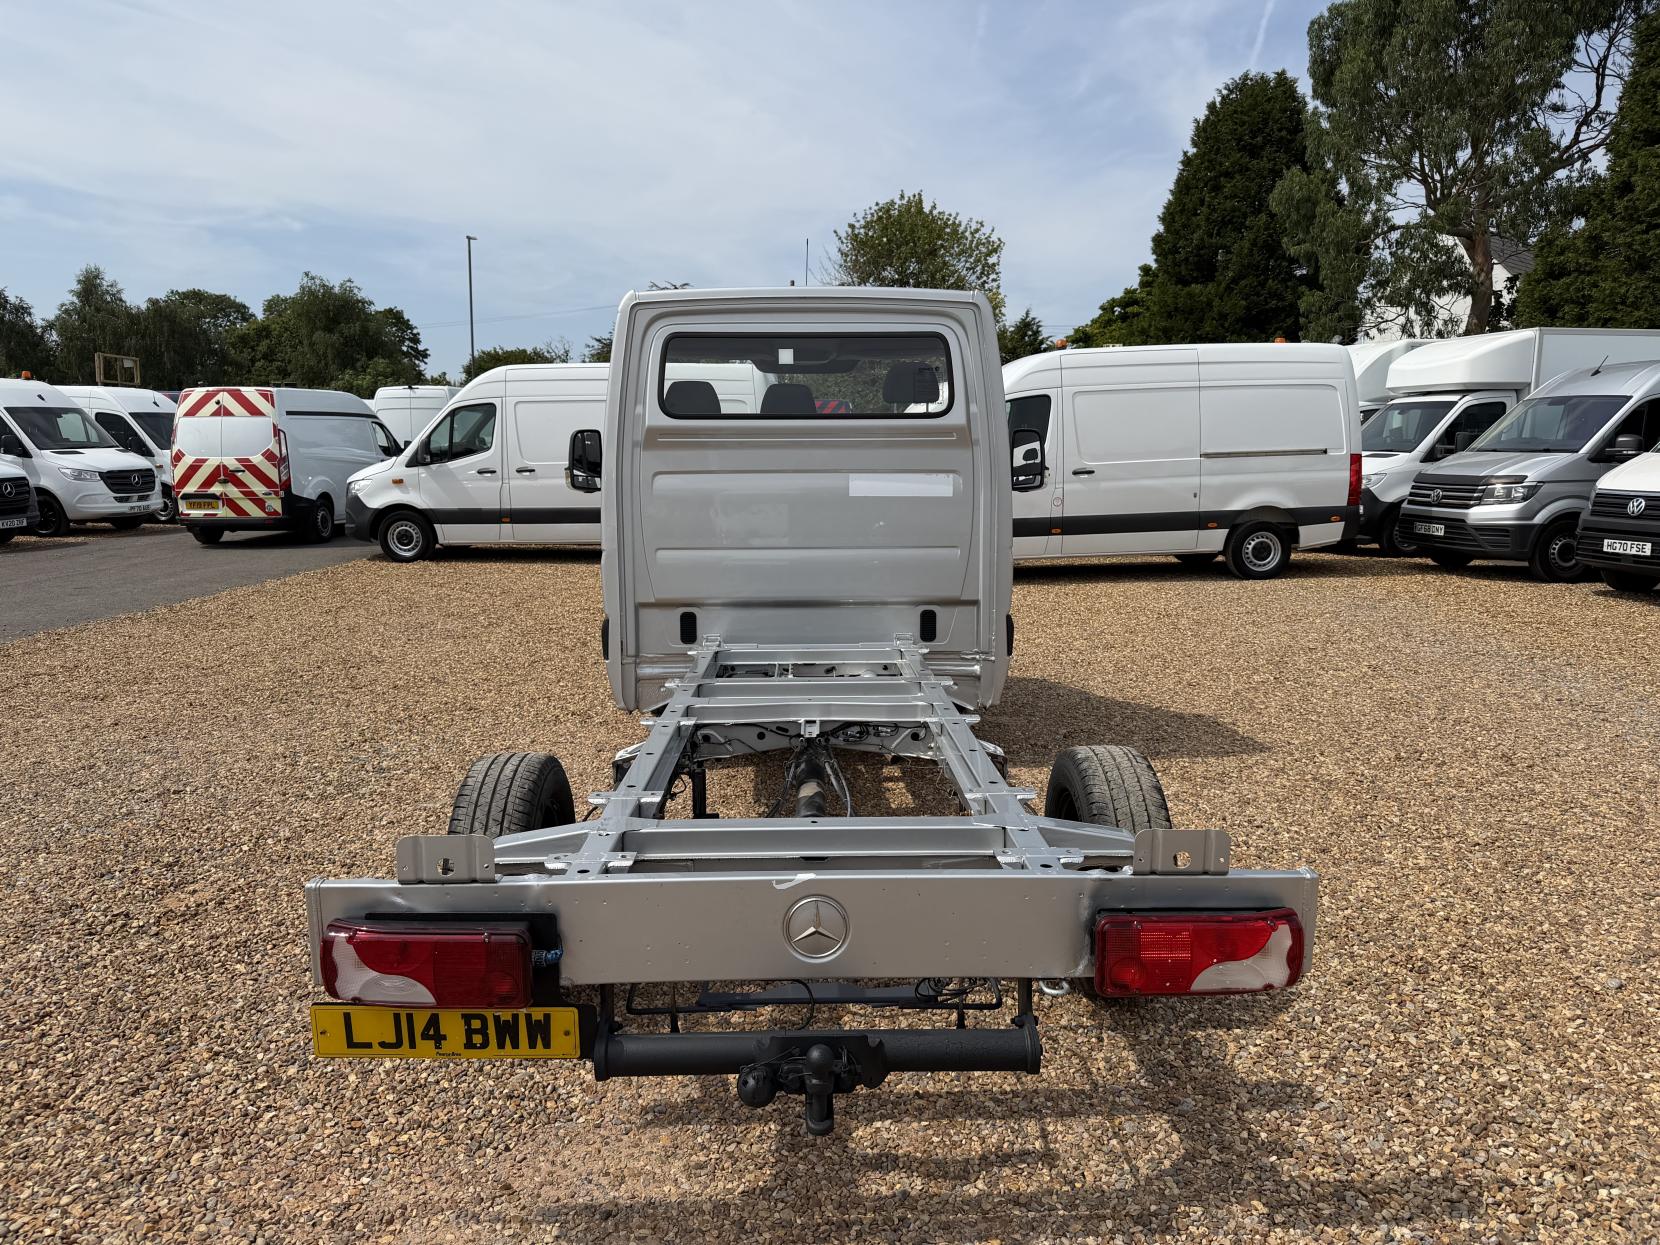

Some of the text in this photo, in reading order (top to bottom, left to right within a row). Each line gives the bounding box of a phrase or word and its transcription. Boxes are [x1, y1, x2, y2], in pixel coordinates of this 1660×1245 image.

[1606, 541, 1647, 553] HG70 FSE
[343, 1012, 553, 1050] LJ14 BWW
